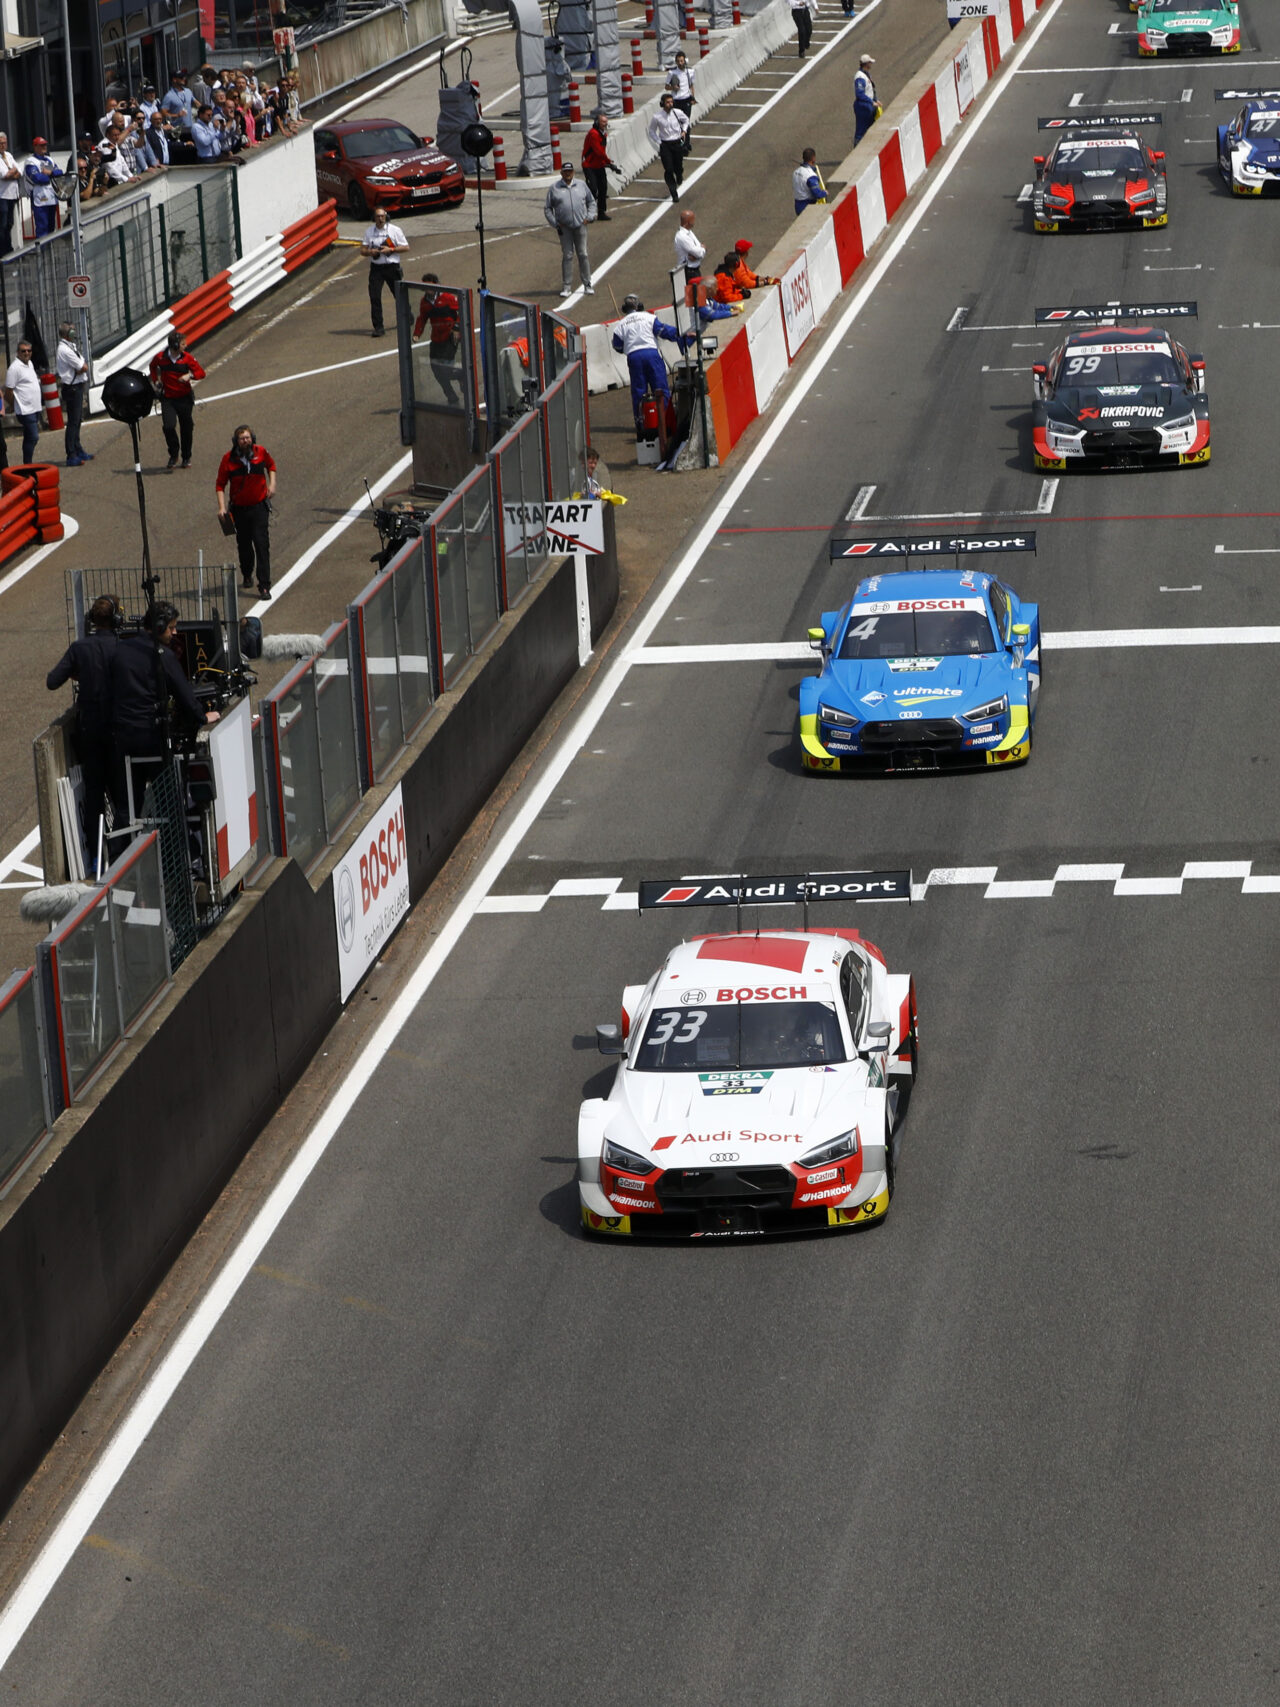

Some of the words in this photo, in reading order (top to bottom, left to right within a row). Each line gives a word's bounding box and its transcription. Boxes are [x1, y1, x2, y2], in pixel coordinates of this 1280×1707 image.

[960, 5, 988, 16] ZONE
[1110, 116, 1156, 124] Sport
[1251, 120, 1277, 132] 47
[1057, 149, 1085, 164] 27
[1074, 308, 1122, 317] Audi
[1129, 306, 1189, 316] Sport
[1102, 344, 1155, 353] BOSCH
[1066, 356, 1102, 376] 99
[879, 541, 941, 553] Audi
[949, 537, 1026, 549] Sport
[897, 600, 965, 611] BOSCH
[848, 617, 880, 640] 4
[893, 687, 963, 696] ultimate
[360, 804, 407, 916] BOSCH
[704, 883, 786, 899] Audi
[798, 880, 898, 894] Sport
[716, 987, 807, 1002] BOSCH
[647, 1011, 708, 1046] 33
[707, 1072, 765, 1081] DEKRA
[721, 1080, 745, 1088] 33
[712, 1087, 752, 1095] DTM
[681, 1131, 732, 1144] Audi
[739, 1130, 803, 1144] Sport
[815, 1171, 836, 1182] Castrol
[623, 1179, 644, 1190] Castrol
